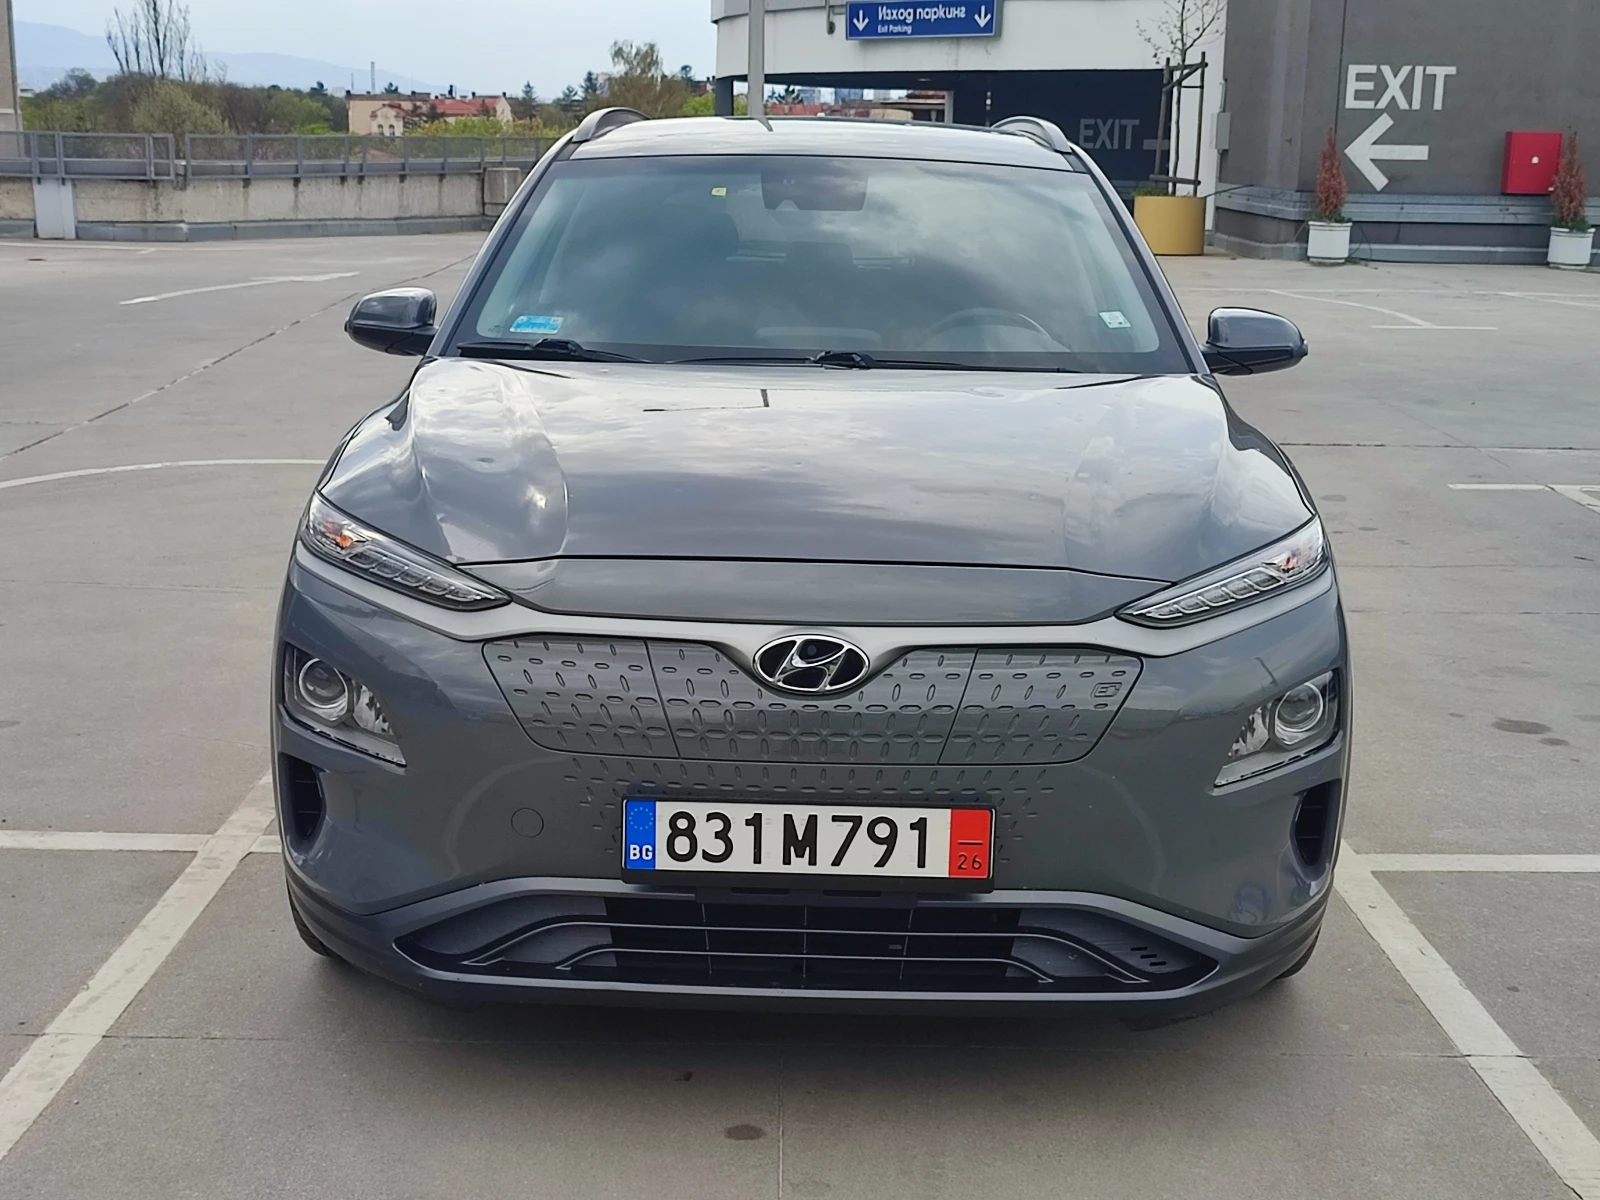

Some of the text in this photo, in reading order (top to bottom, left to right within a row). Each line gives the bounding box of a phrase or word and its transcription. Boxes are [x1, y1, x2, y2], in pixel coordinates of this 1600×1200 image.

[878, 4, 966, 24] Изход паркинг
[878, 25, 912, 34] Exit Parking
[1345, 64, 1457, 111] EXIT
[1079, 118, 1140, 150] EXIT
[629, 844, 653, 860] BG
[957, 853, 982, 871] 26
